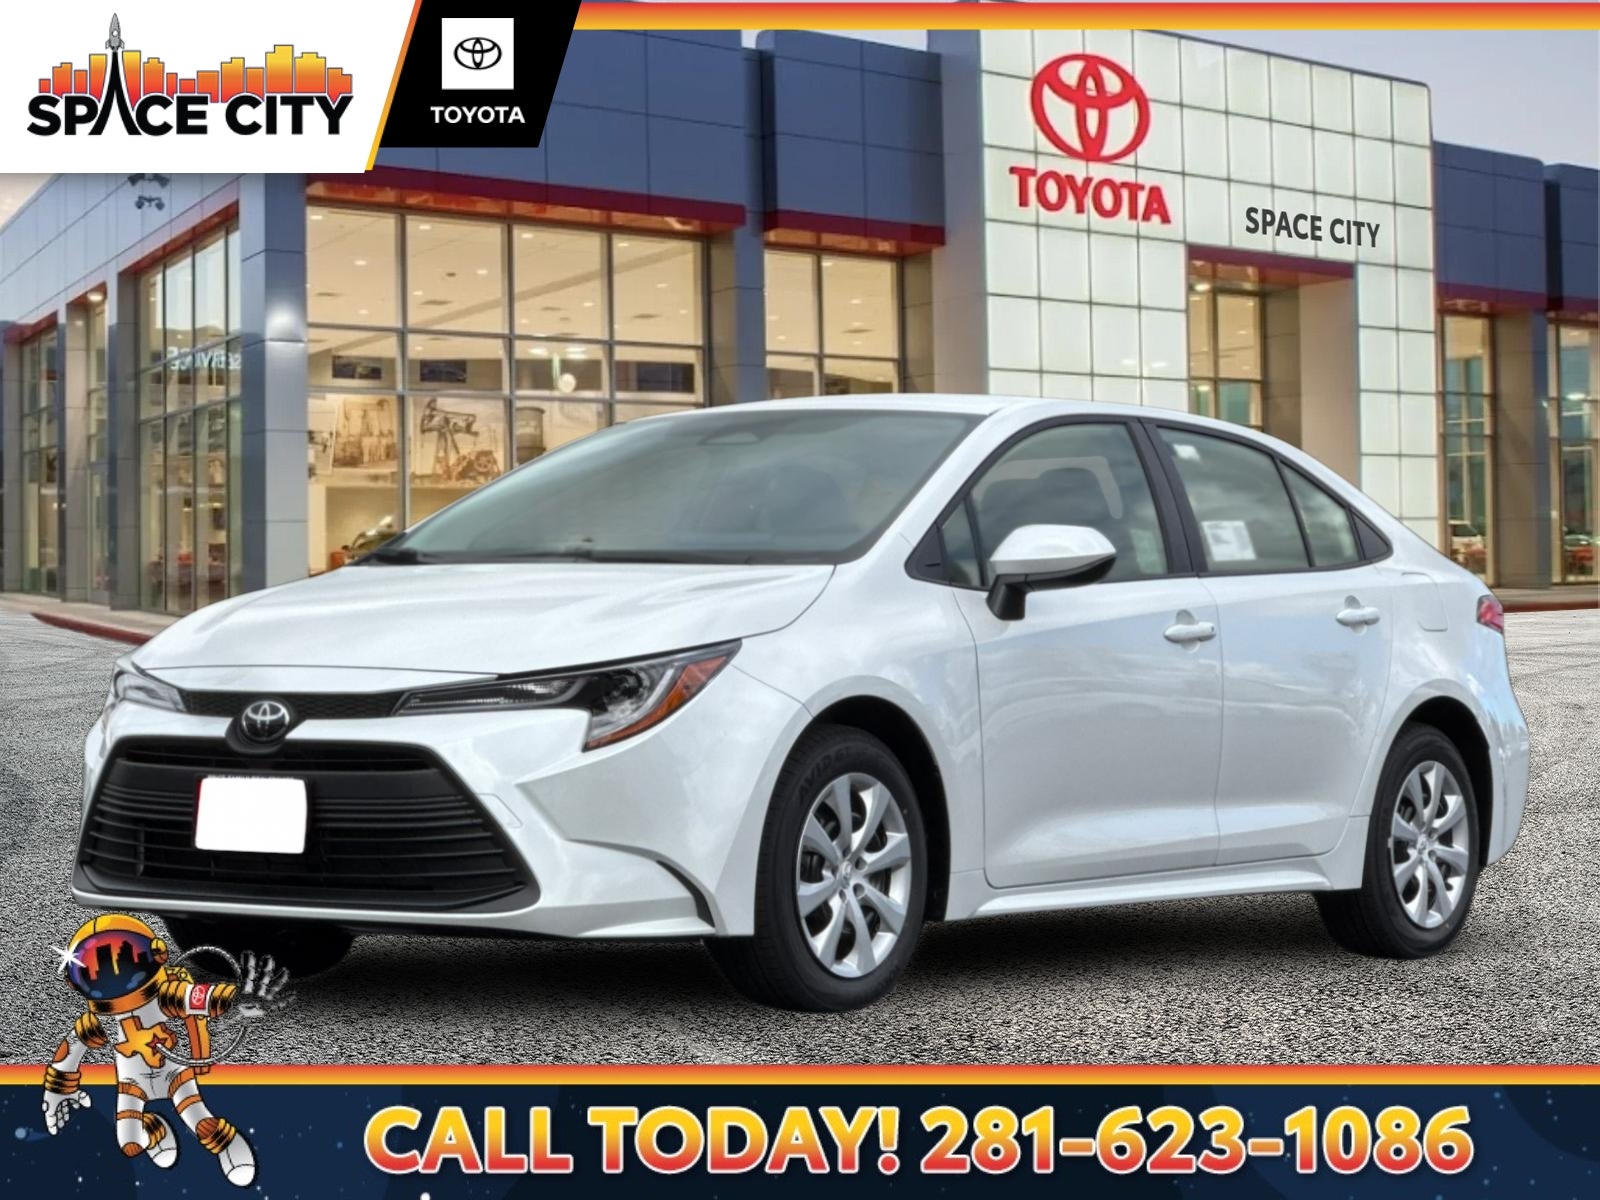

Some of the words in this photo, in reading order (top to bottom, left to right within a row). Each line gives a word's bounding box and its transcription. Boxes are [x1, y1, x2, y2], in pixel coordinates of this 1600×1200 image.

[1009, 164, 1171, 224] TOYOTA
[1245, 206, 1323, 242] SPACE
[1329, 217, 1381, 248] CITY
